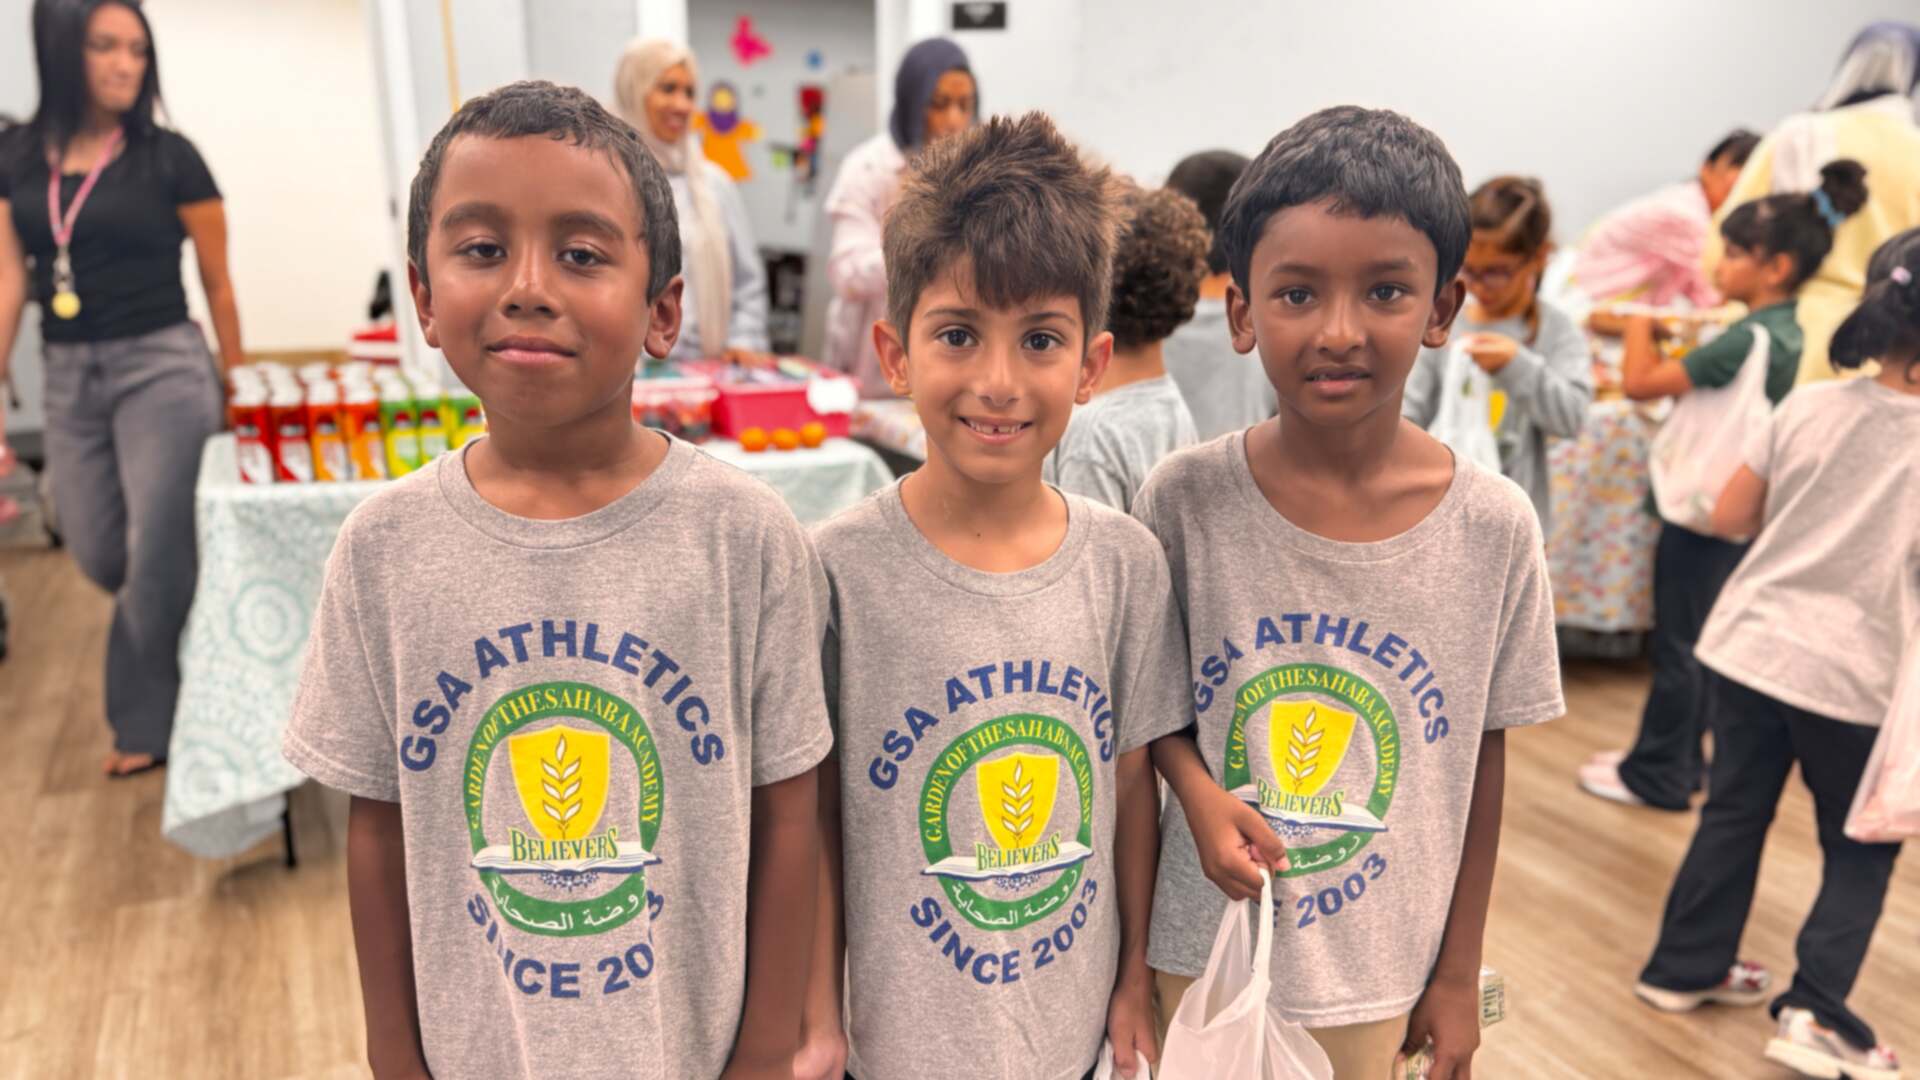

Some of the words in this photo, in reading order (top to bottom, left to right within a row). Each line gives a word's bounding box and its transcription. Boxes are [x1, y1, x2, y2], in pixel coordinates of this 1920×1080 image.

[400, 670, 474, 772] GSA
[473, 619, 725, 767] ATHLETICS
[1194, 637, 1245, 715] GSA
[1254, 612, 1450, 744] ATHLETICS
[868, 706, 940, 791] GSA
[944, 659, 1114, 763] ATHLETICS
[925, 763, 953, 842] GARDEN
[1257, 776, 1344, 817] BELIEVERS
[509, 827, 618, 862] BELIEVERS
[975, 831, 1062, 871] BELIEVERS
[1295, 852, 1388, 929] 2003
[597, 889, 665, 995] 203
[910, 896, 1021, 985] SINCE
[1031, 878, 1098, 970] 2003
